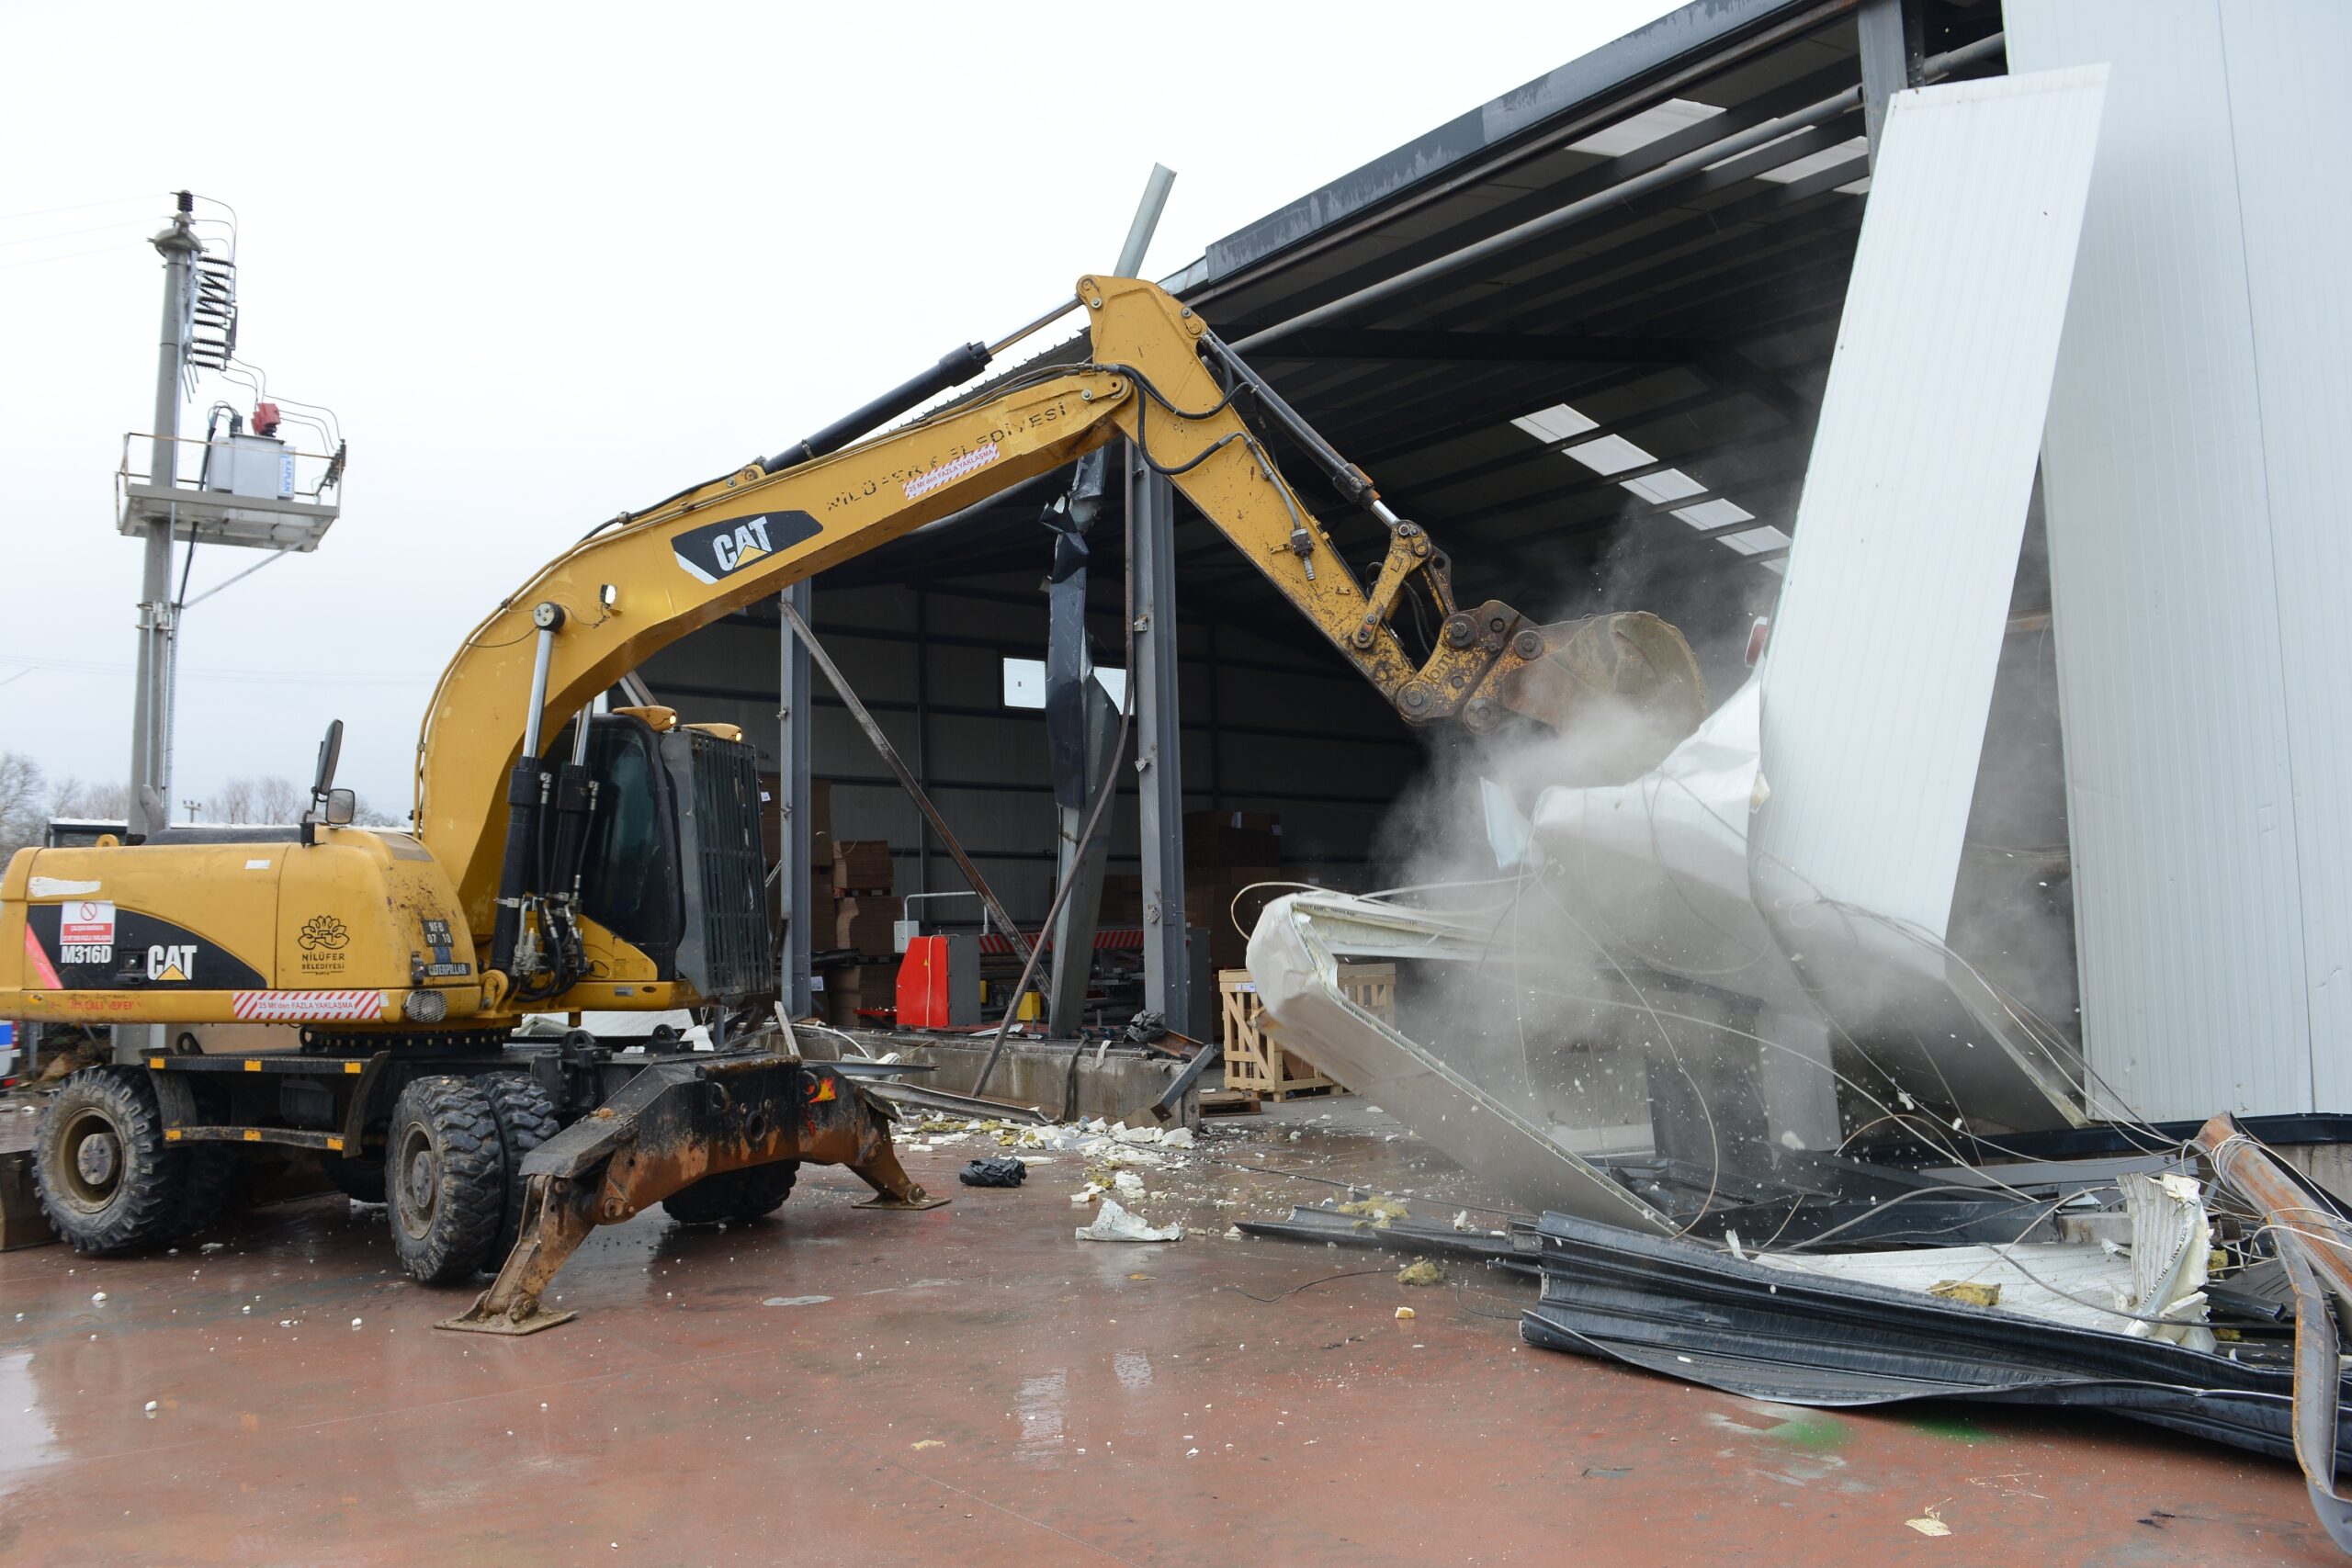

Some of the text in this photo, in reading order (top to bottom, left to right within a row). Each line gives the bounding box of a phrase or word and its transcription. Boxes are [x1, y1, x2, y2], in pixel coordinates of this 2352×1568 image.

[937, 465, 958, 479] FAZLA
[957, 448, 995, 468] YAKLAŞMA
[712, 515, 773, 571] CAT
[426, 933, 452, 943] 07 10
[61, 945, 112, 964] M316D
[147, 944, 198, 980] CAT
[301, 951, 345, 962] NİLÜFER
[427, 964, 467, 976] CATERPILLAR
[314, 1001, 353, 1010] YAKLAŞMA
